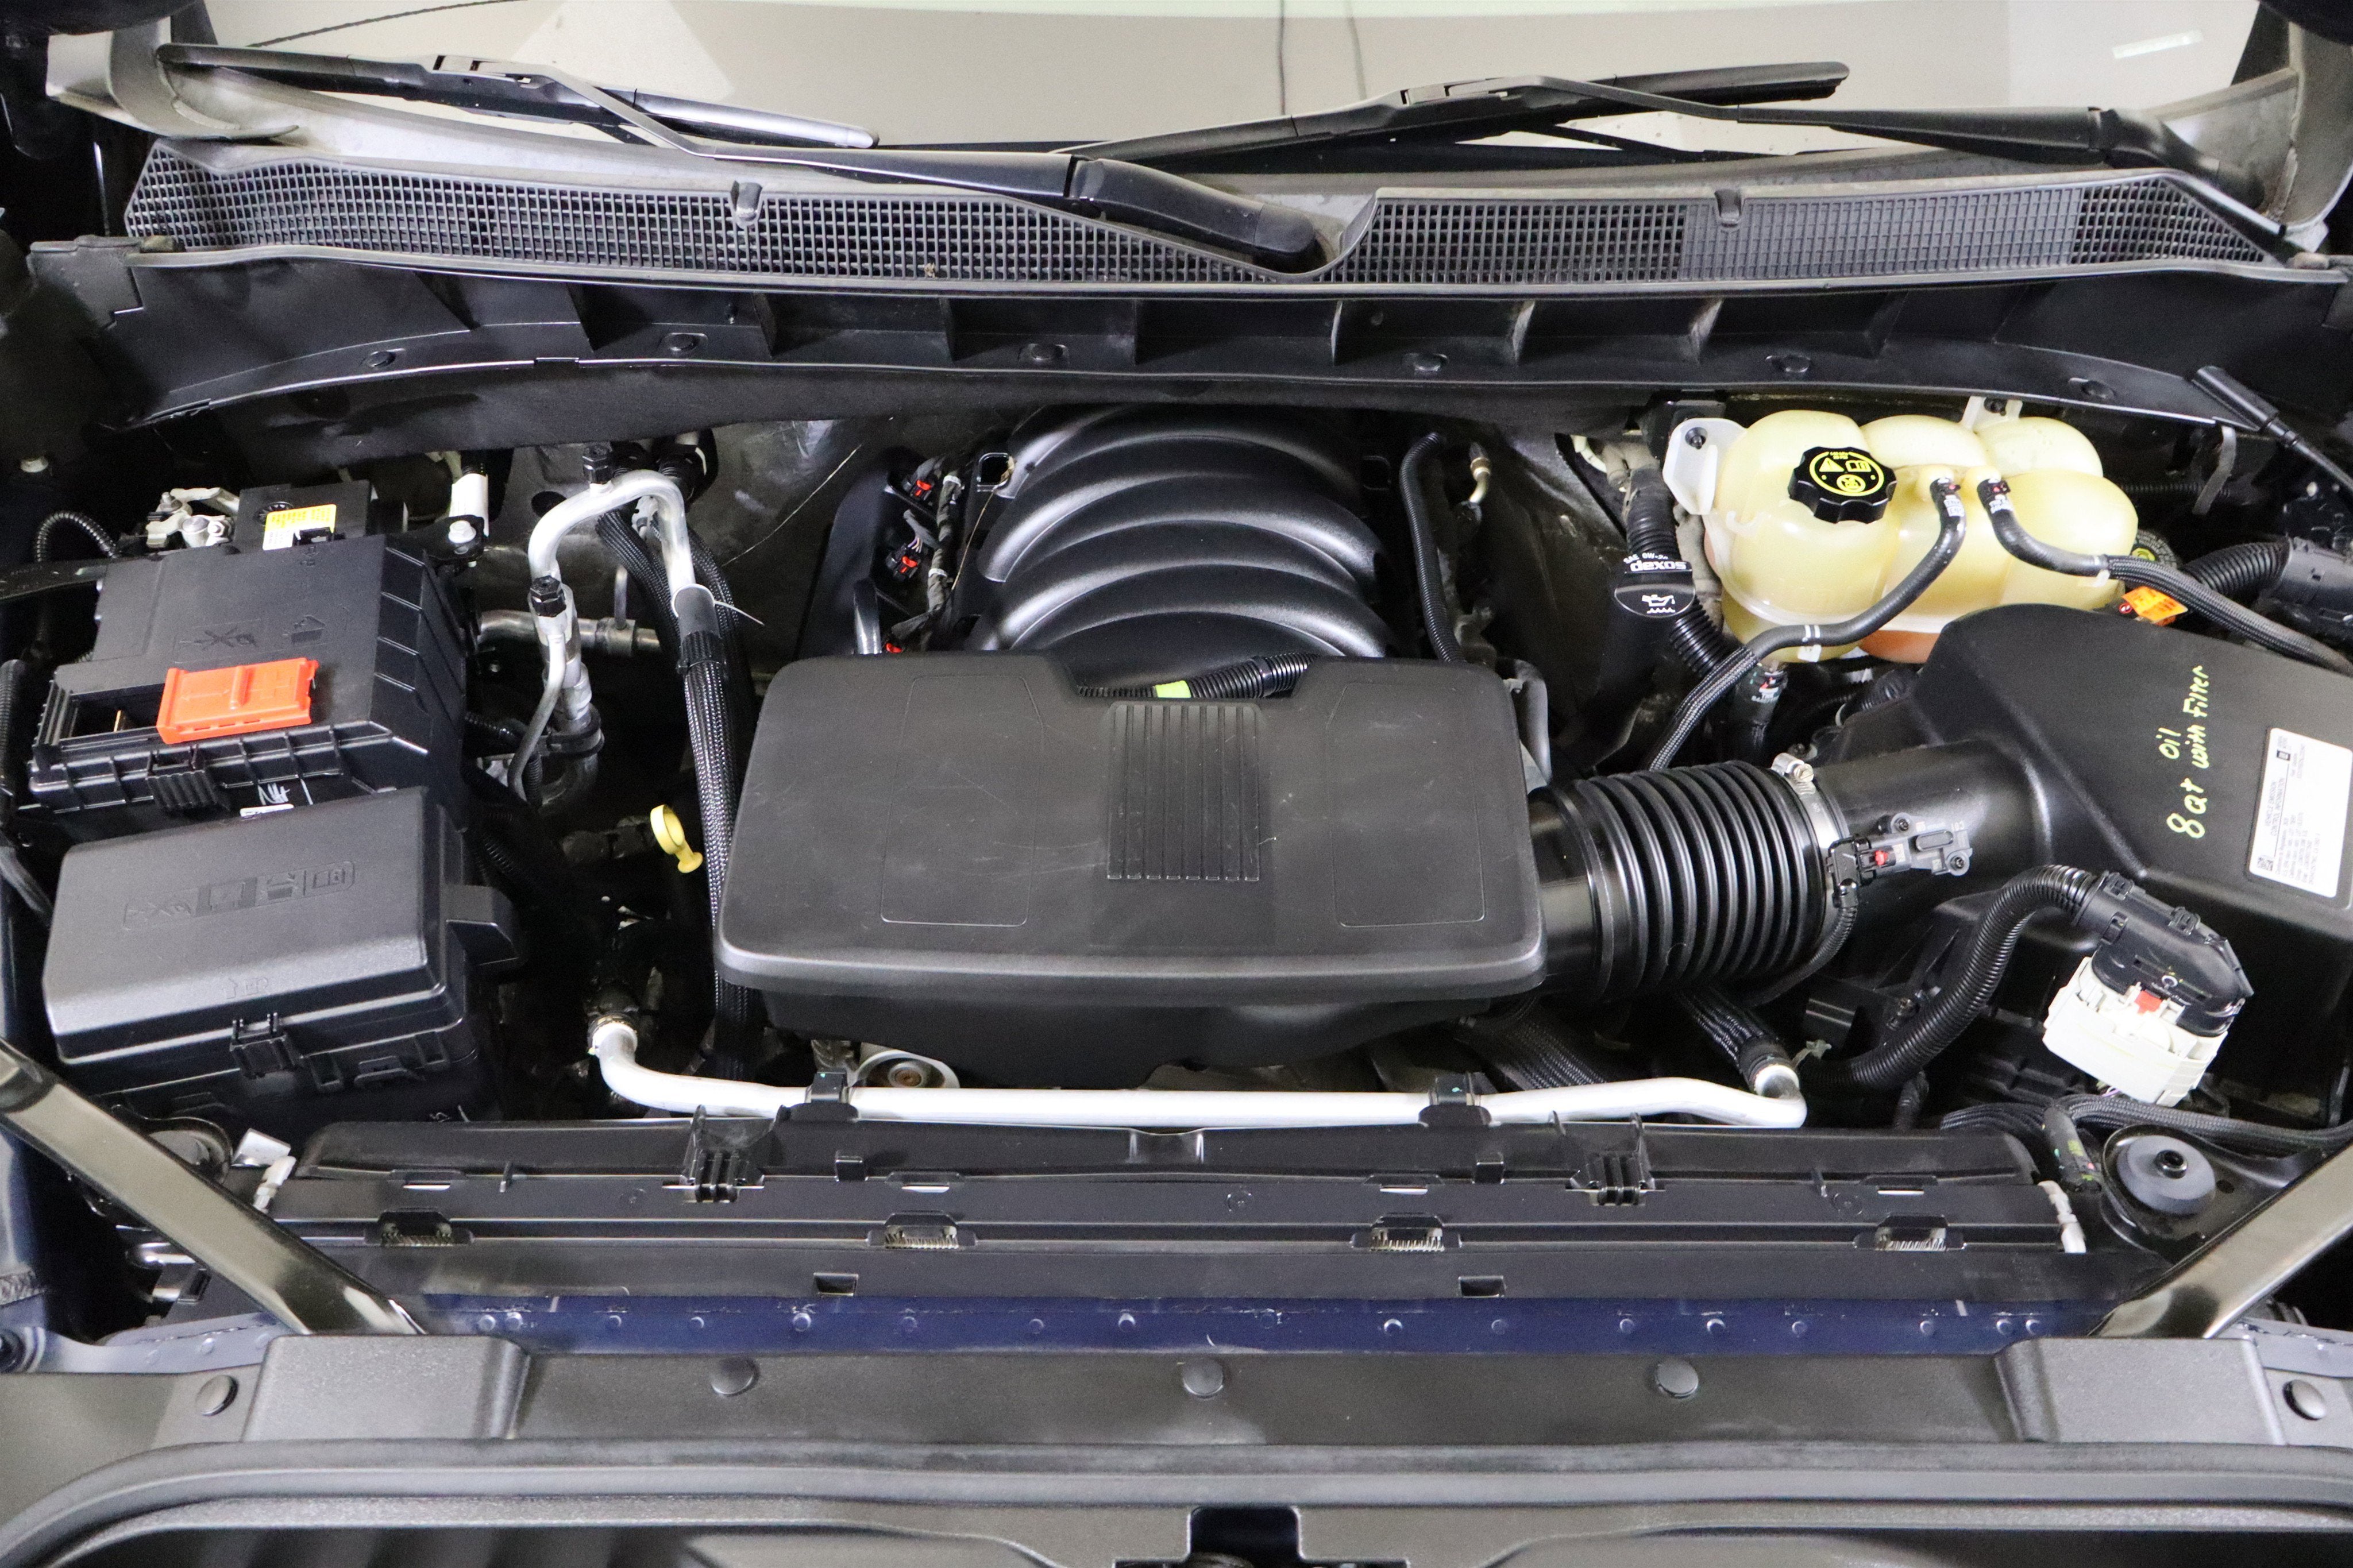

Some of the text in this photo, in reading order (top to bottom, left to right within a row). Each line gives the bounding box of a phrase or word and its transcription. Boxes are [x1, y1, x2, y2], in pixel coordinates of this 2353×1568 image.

[1630, 560, 1687, 571] dexos
[2155, 727, 2182, 760] Oil
[2184, 724, 2210, 769] with
[2166, 812, 2206, 839] 8
